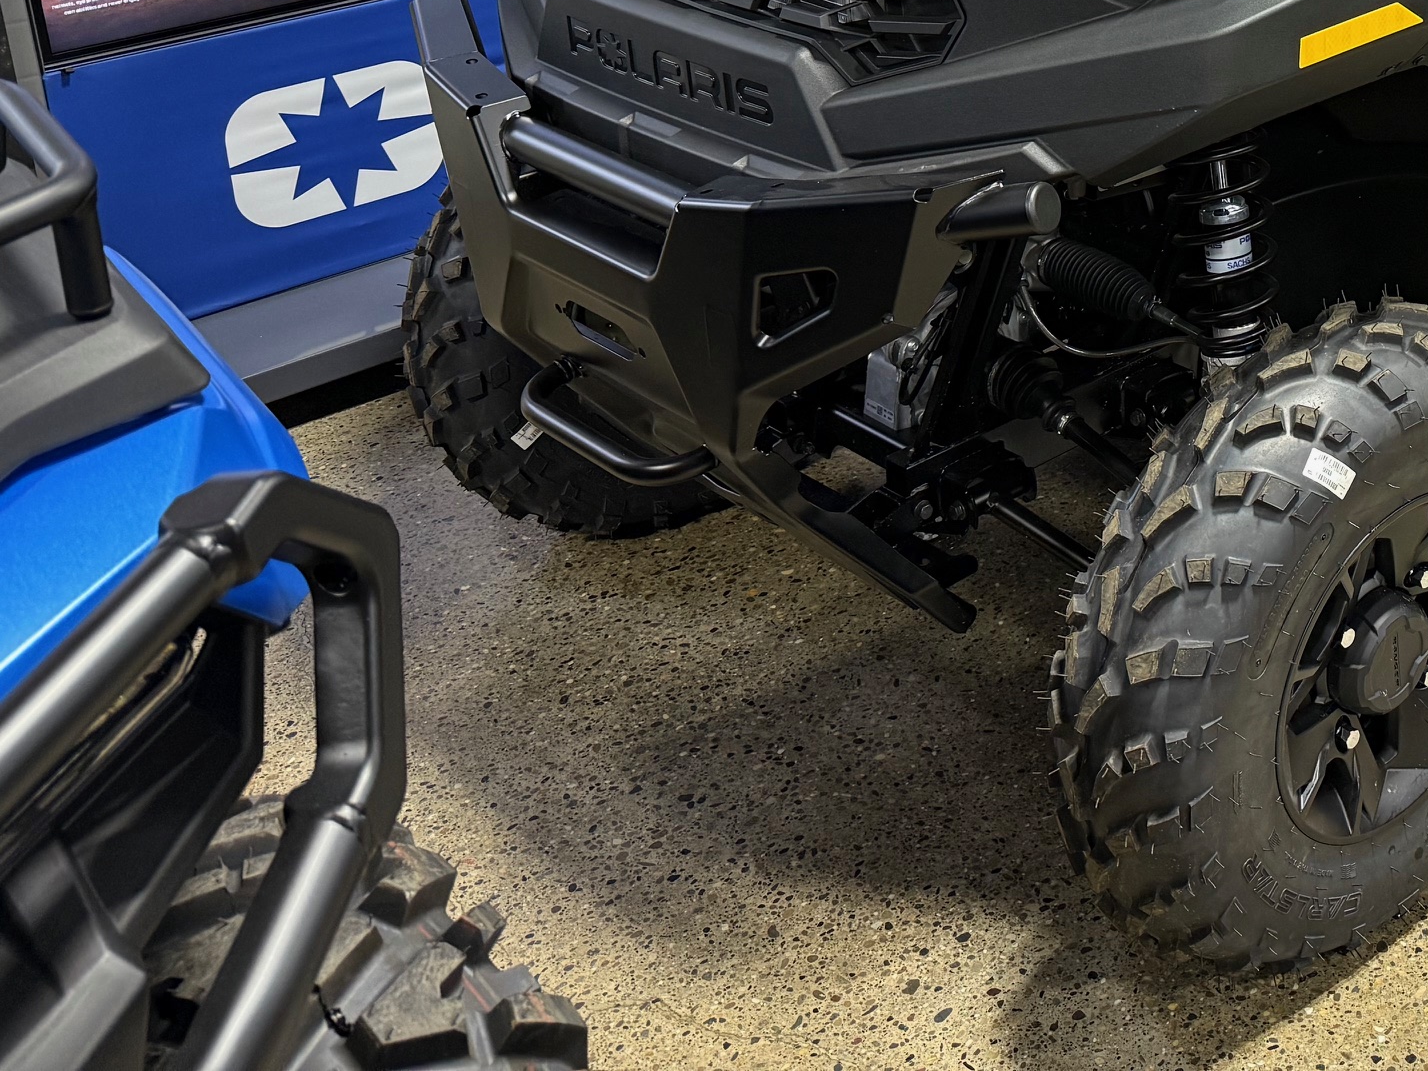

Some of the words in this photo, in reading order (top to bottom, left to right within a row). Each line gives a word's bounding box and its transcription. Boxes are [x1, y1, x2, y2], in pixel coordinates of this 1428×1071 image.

[566, 15, 774, 127] POLARIS
[1227, 257, 1251, 270] SACHS
[1242, 851, 1362, 921] CARLSTAR
